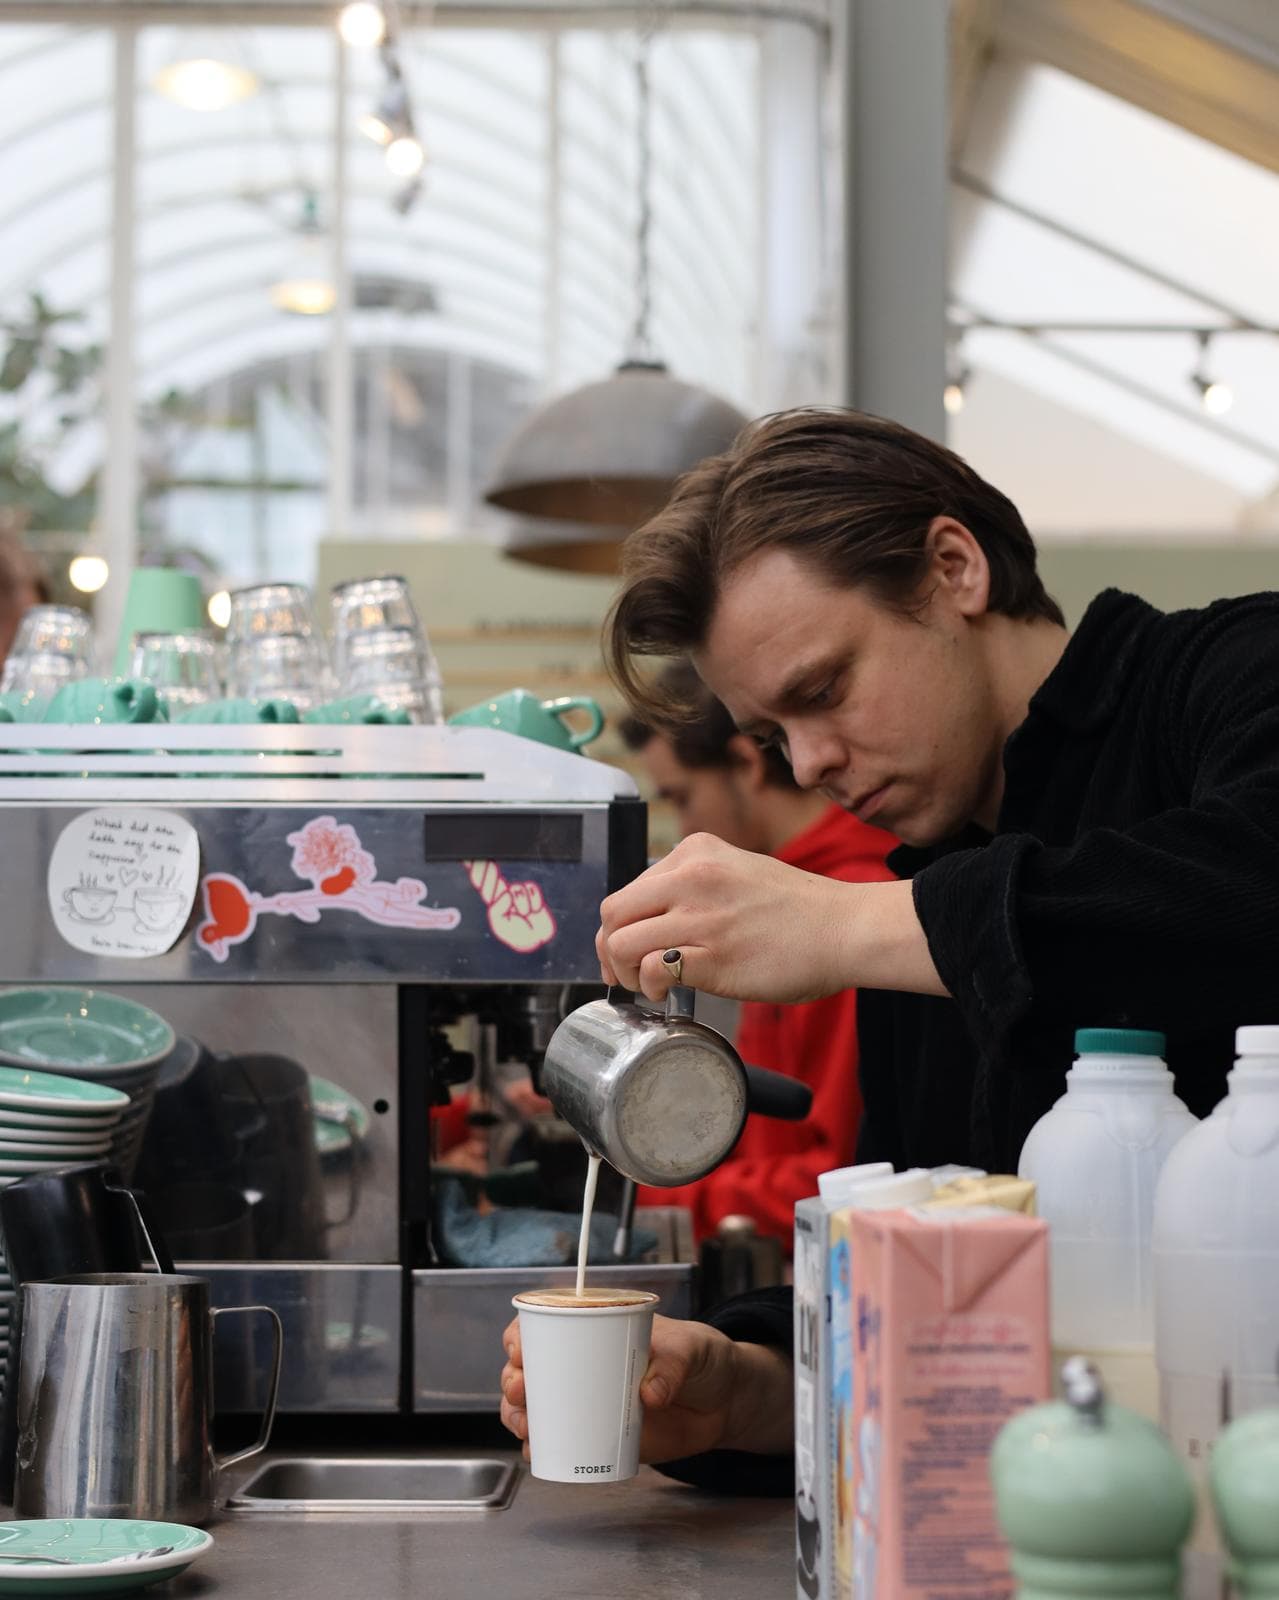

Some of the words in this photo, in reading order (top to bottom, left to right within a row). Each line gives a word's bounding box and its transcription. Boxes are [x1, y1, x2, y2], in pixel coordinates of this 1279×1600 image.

[94, 817, 122, 830] What
[130, 820, 149, 833] did
[574, 1464, 612, 1474] STORES
